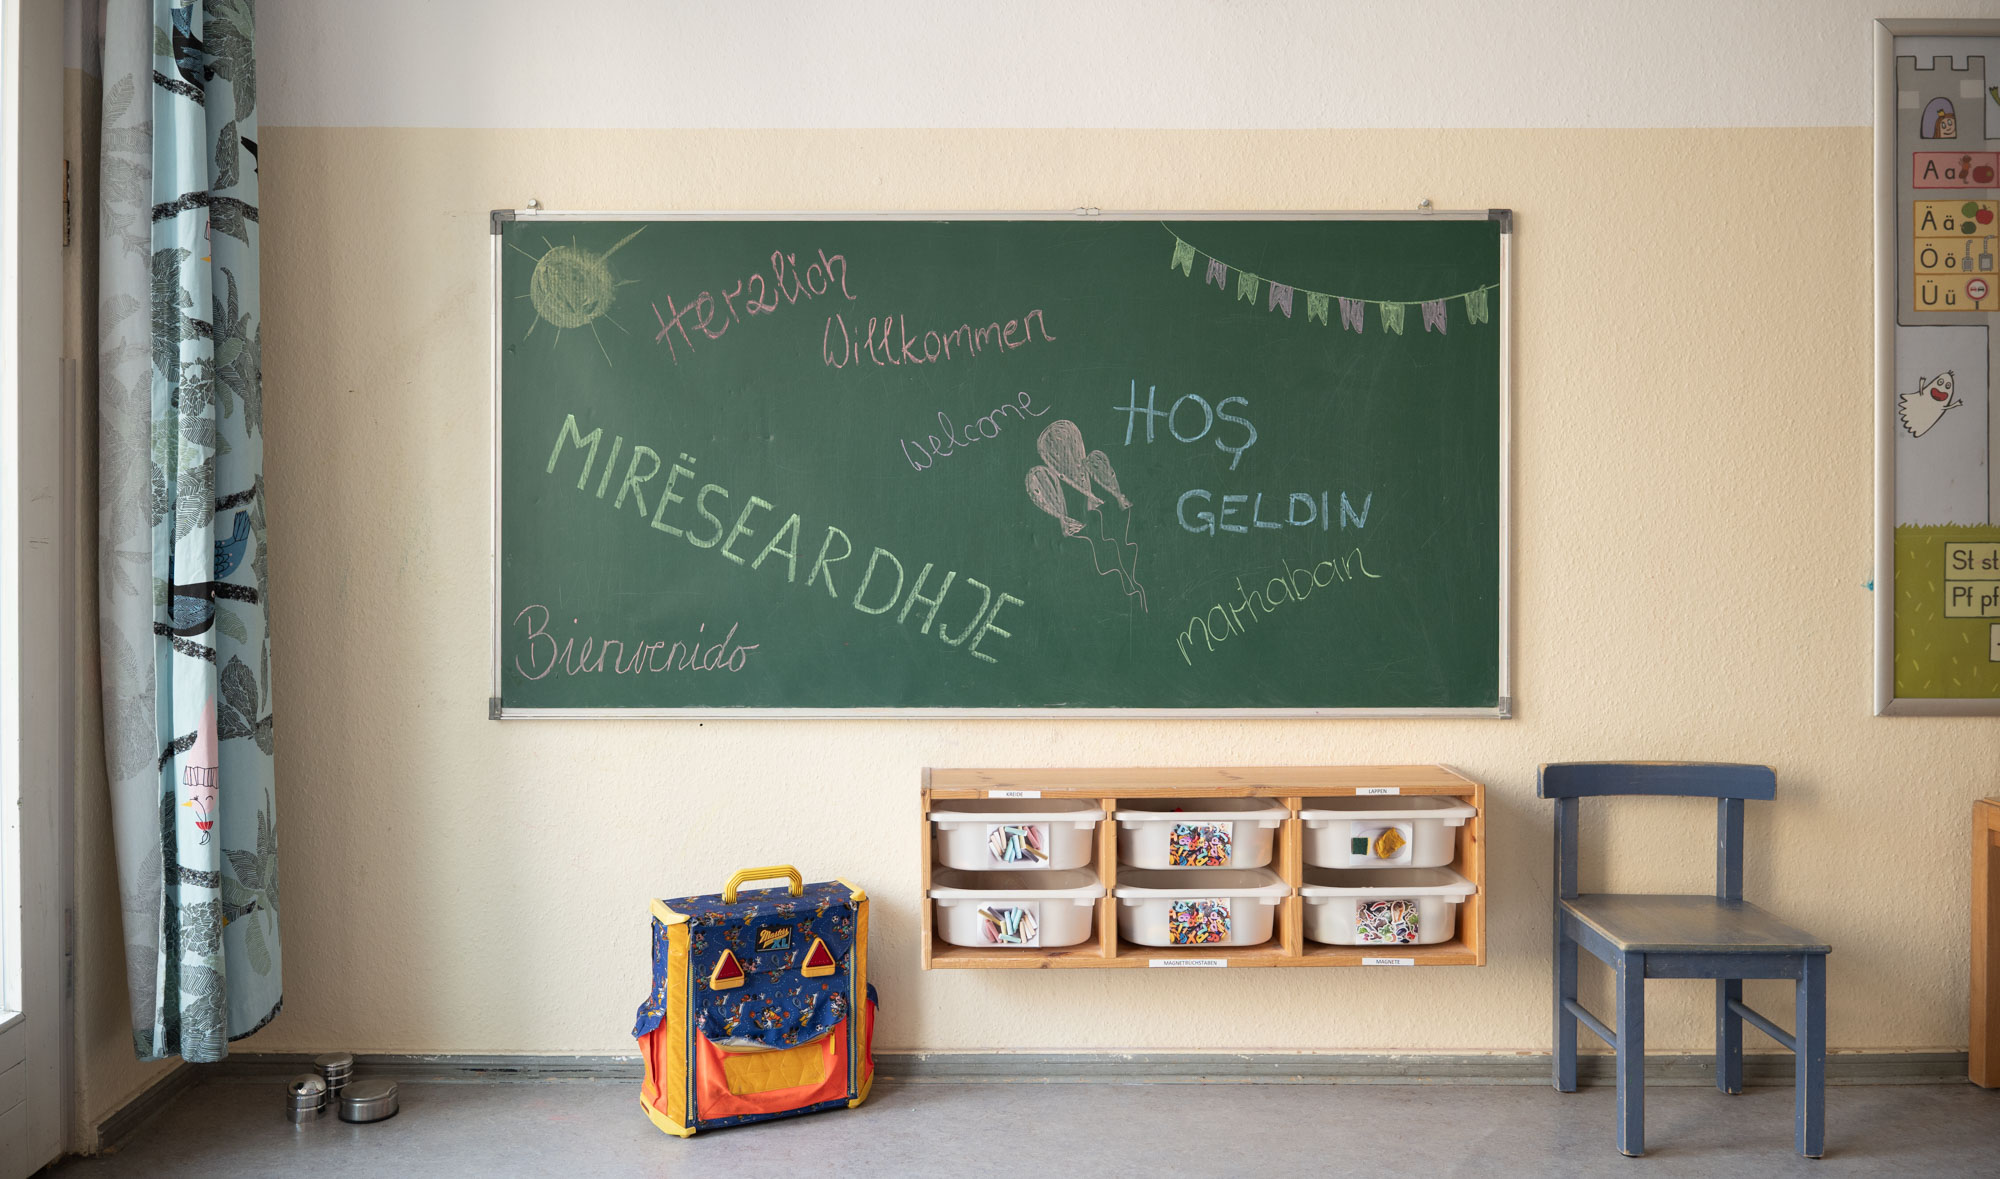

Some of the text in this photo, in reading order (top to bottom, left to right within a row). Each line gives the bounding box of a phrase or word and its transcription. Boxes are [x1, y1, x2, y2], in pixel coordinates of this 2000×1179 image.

[1922, 159, 1956, 180] A a
[1920, 205, 1955, 231] Ä ä
[1920, 243, 1956, 269] Ö ö
[651, 247, 857, 366] Herzlich
[1921, 279, 1956, 306] Ü ü
[822, 308, 1056, 369] Willkommen
[1113, 378, 1258, 471] HOŞ
[1176, 488, 1373, 537] GELDIN
[1952, 549, 1999, 571] St st
[1952, 586, 1999, 616] Pf pf
[512, 603, 760, 681] Bienvenido
[771, 937, 789, 949] XL
